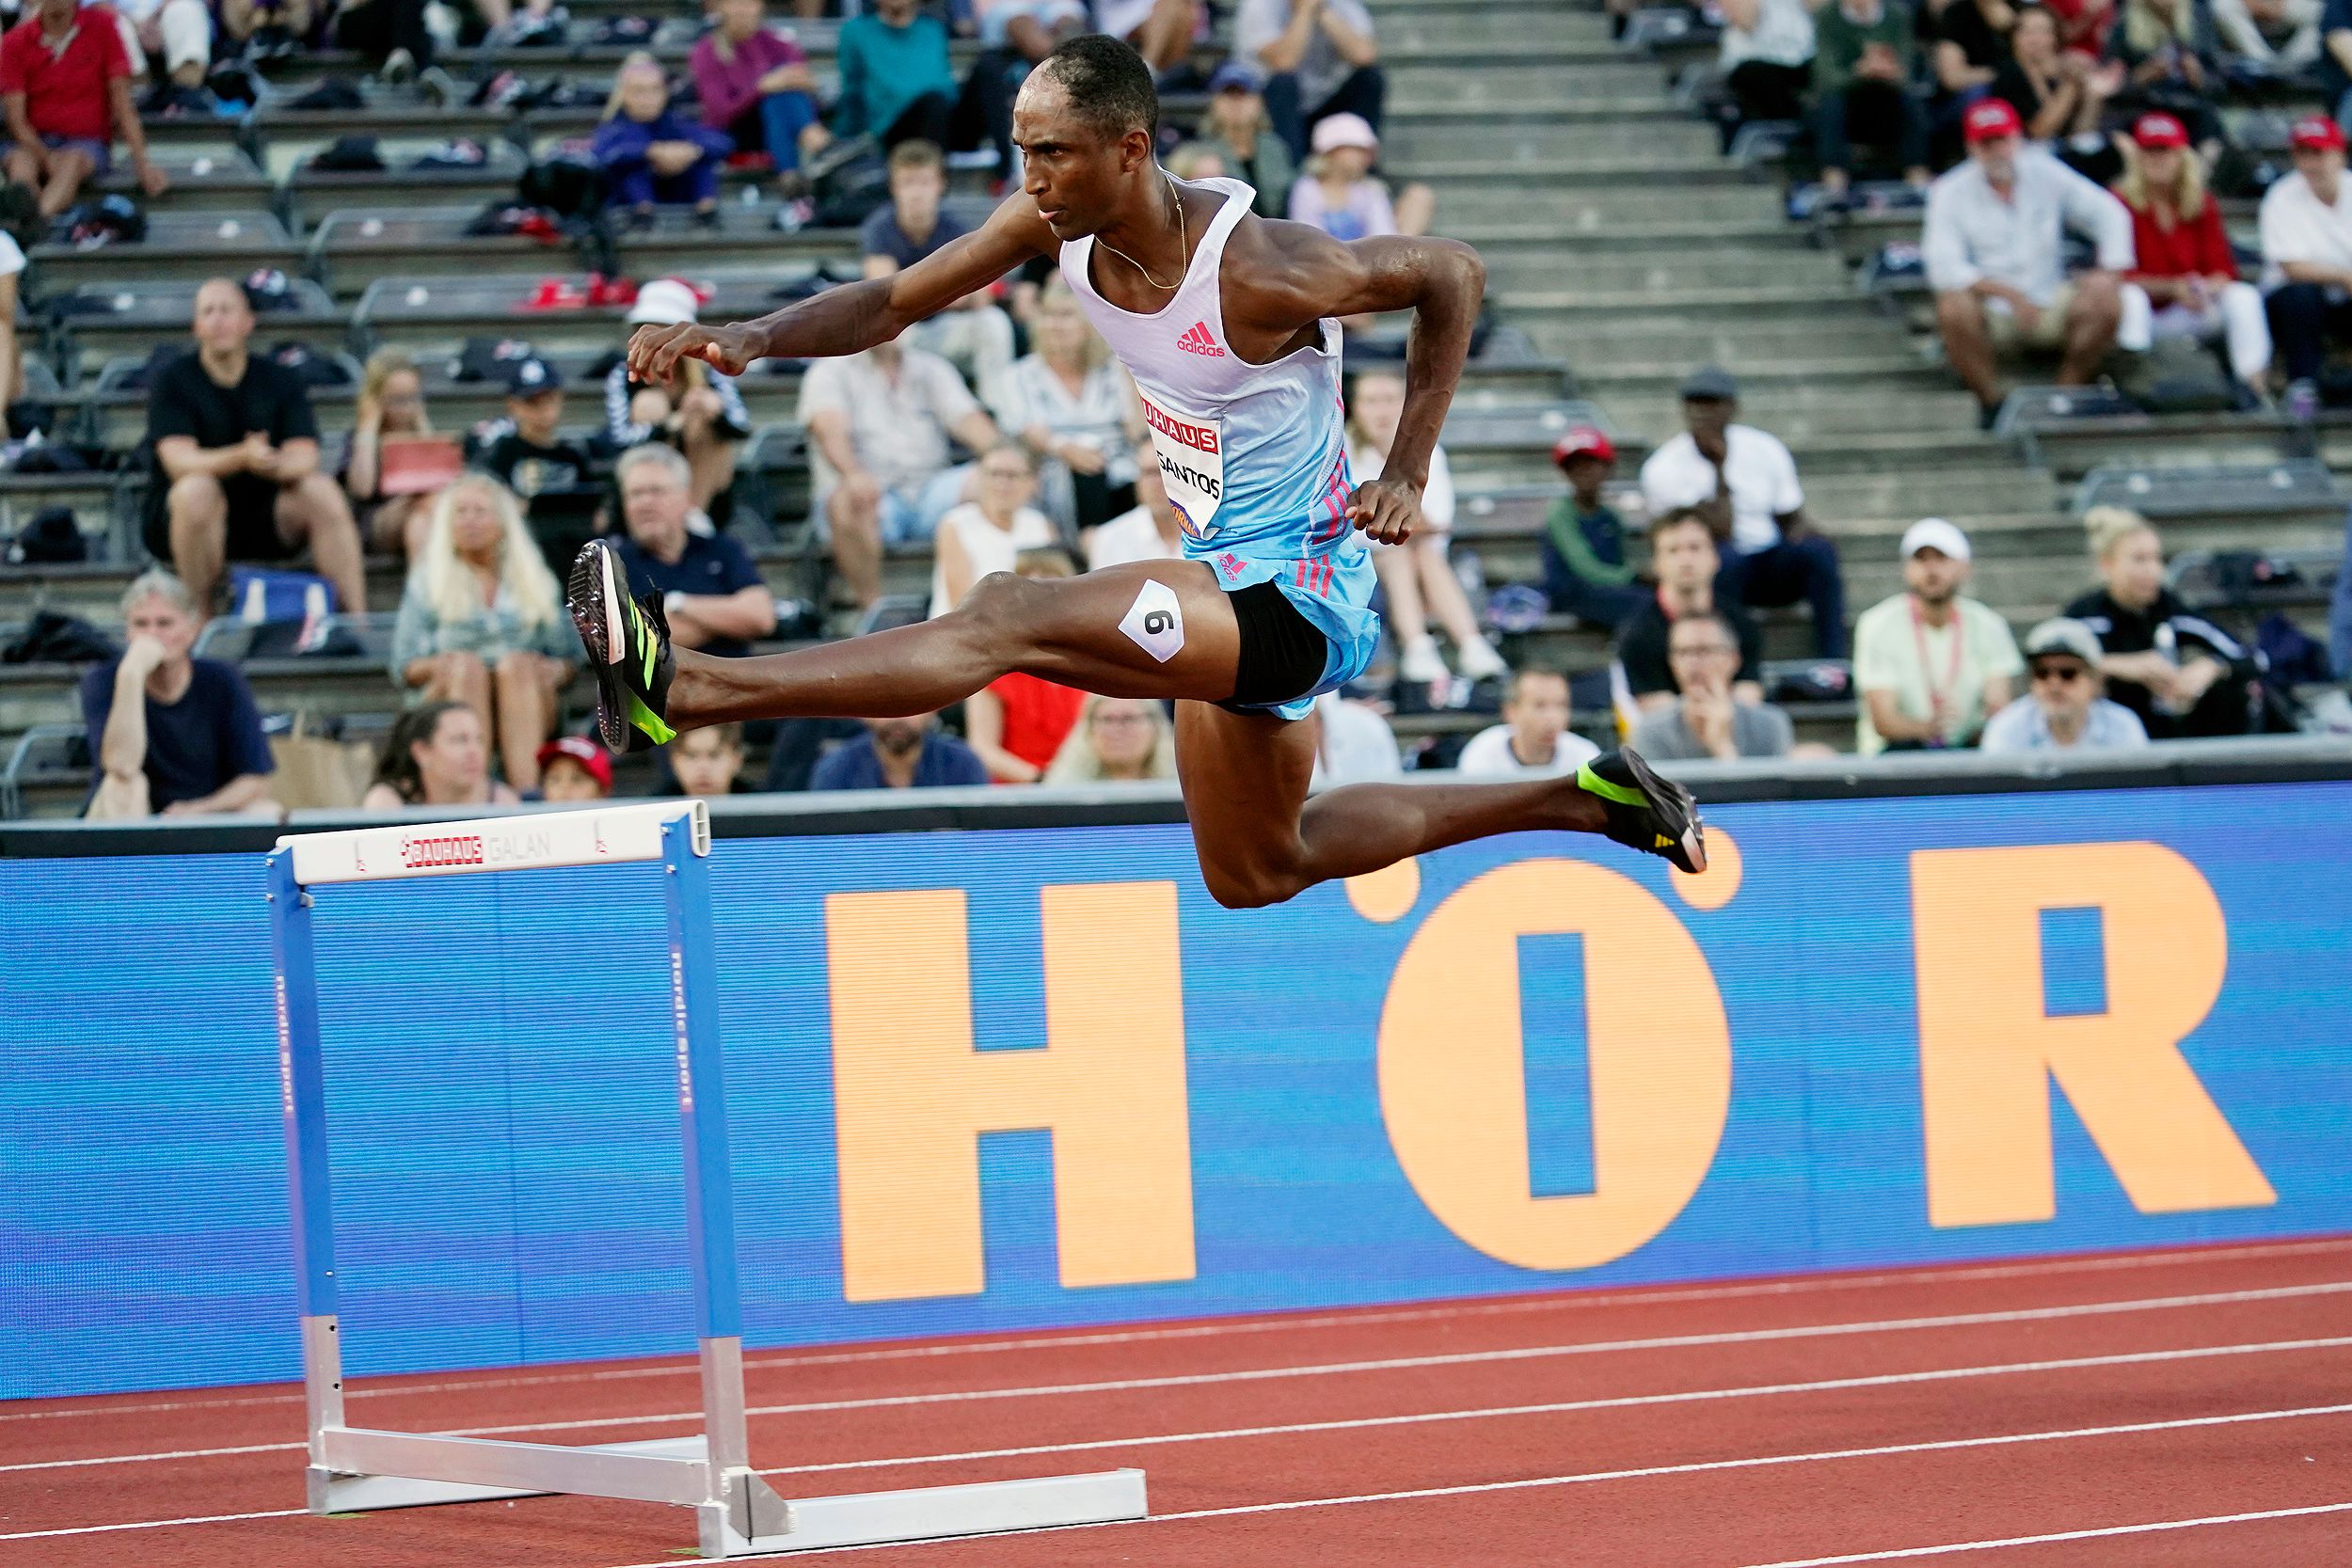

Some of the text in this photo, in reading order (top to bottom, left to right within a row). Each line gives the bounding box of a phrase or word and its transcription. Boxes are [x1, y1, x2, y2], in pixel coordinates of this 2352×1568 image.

[1177, 340, 1225, 357] adidas
[1142, 401, 1216, 449] UHAUS
[1144, 610, 1174, 635] 6
[410, 832, 551, 865] BAUHAUS GALAN
[276, 976, 290, 1047] nordic
[671, 953, 693, 1105] nordic sport
[826, 828, 2277, 1303] HÖR
